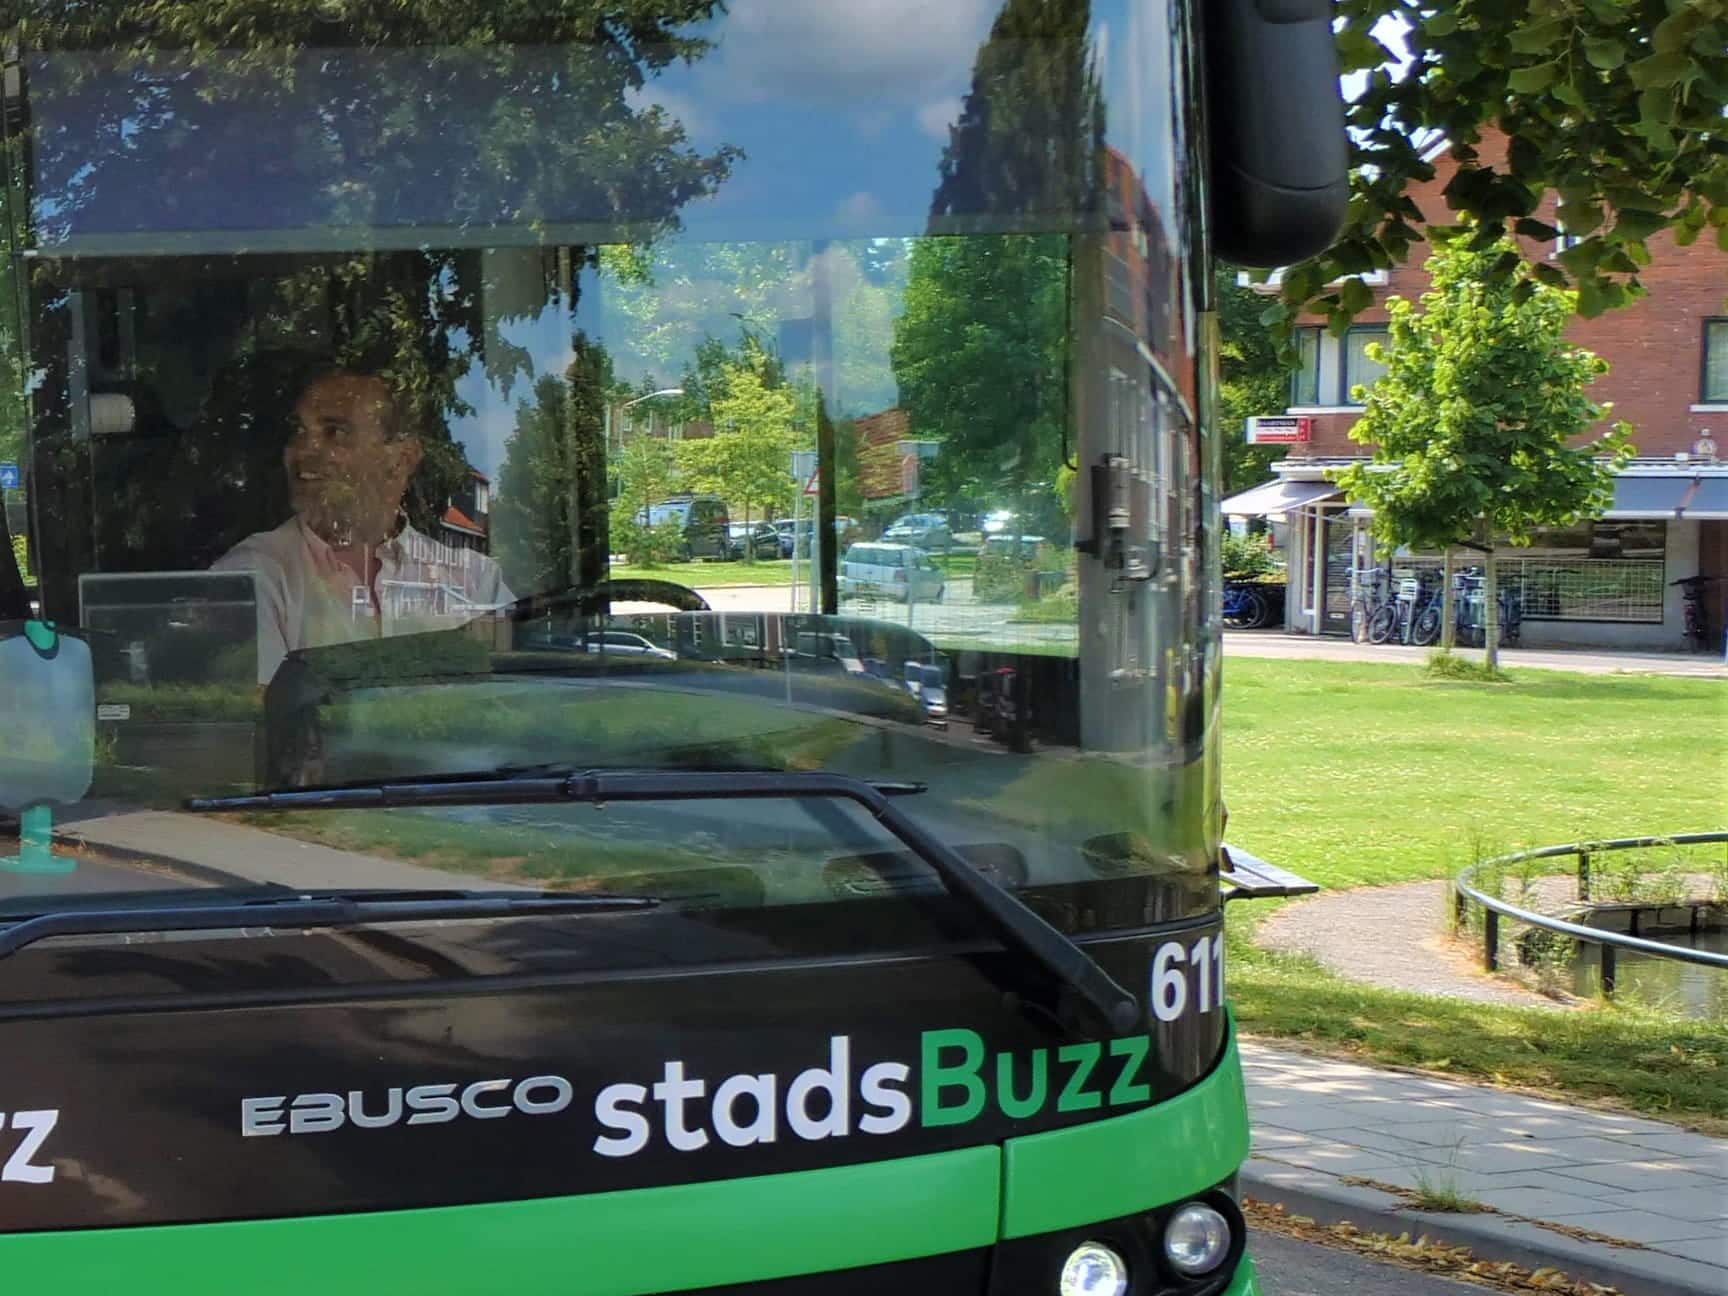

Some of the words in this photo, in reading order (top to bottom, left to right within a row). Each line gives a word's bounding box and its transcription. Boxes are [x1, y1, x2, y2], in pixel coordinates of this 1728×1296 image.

[1152, 930, 1224, 1022] 611
[241, 1075, 574, 1137] EBUSCO
[592, 1027, 1151, 1157] stadsBuzz
